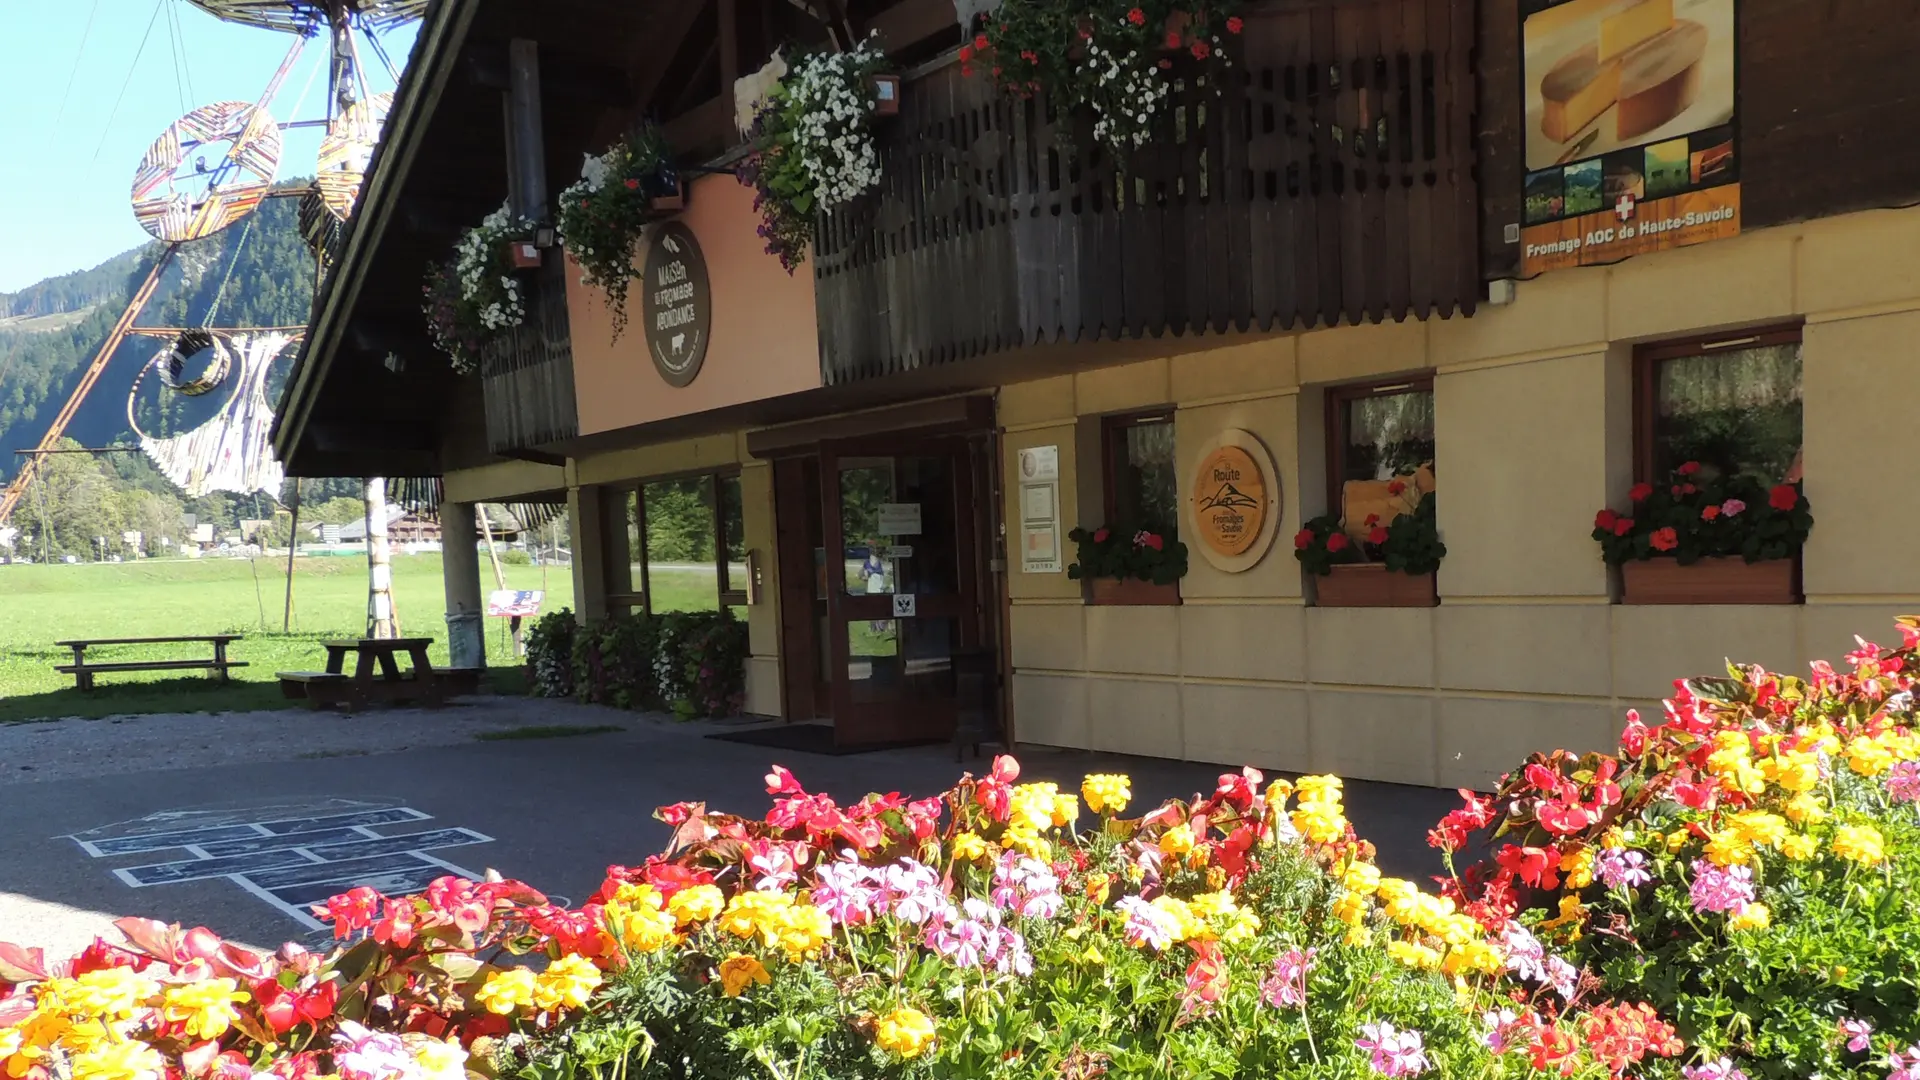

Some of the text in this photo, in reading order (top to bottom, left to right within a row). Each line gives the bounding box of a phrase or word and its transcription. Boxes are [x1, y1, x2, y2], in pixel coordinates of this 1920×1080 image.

[1527, 238, 1581, 258] Fromage
[1585, 228, 1615, 246] AOC
[1618, 225, 1635, 239] de
[1640, 205, 1734, 236] Haute-Savoie
[1214, 469, 1240, 482] Route
[1213, 514, 1244, 526] Fromages
